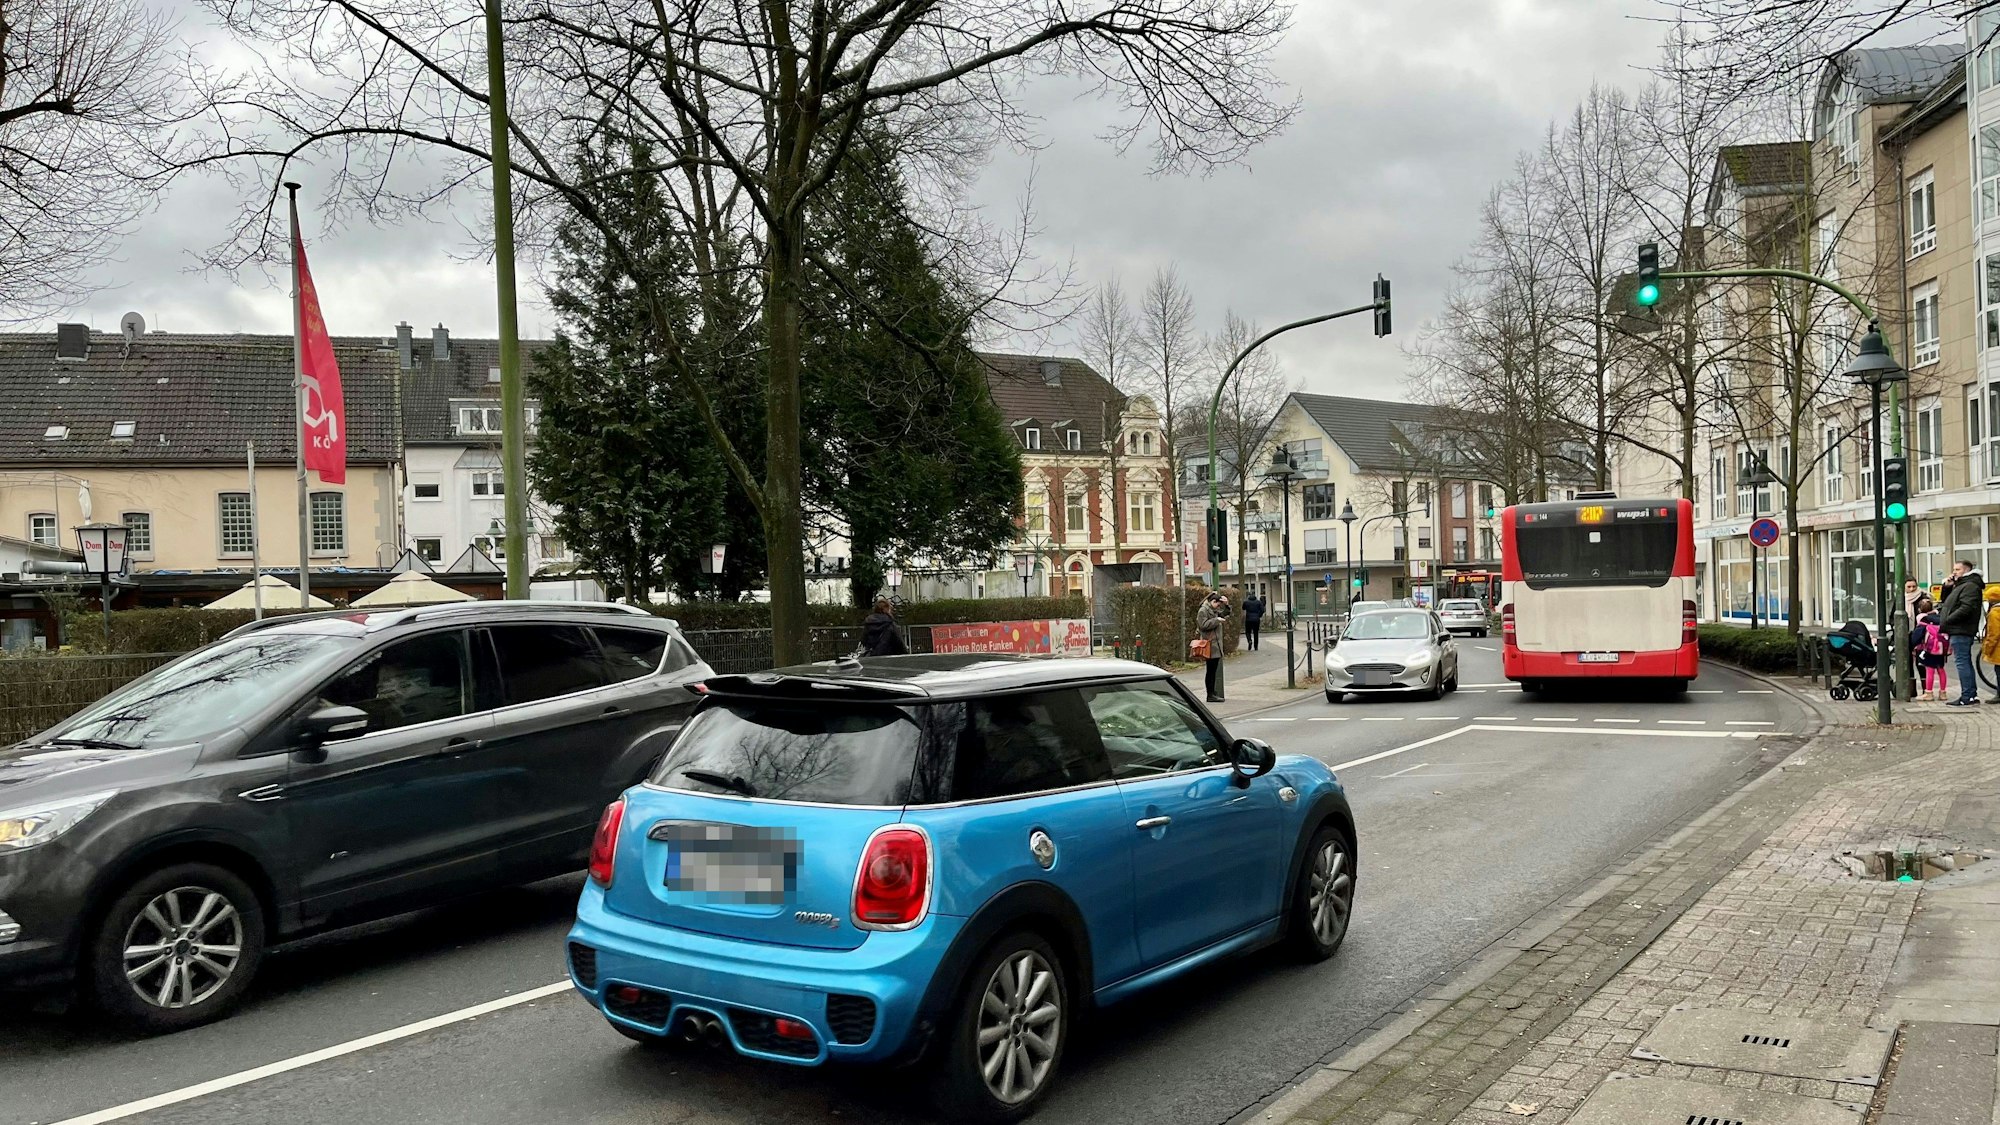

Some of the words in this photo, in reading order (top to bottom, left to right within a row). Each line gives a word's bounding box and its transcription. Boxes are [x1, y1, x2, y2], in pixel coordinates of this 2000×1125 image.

[1617, 508, 1650, 520] wupsi
[85, 540, 102, 550] Dom
[109, 540, 123, 550] Dom
[951, 642, 970, 653] Jahre
[971, 641, 988, 652] Rote
[989, 640, 1014, 651] Funken
[794, 911, 833, 924] COOPER
